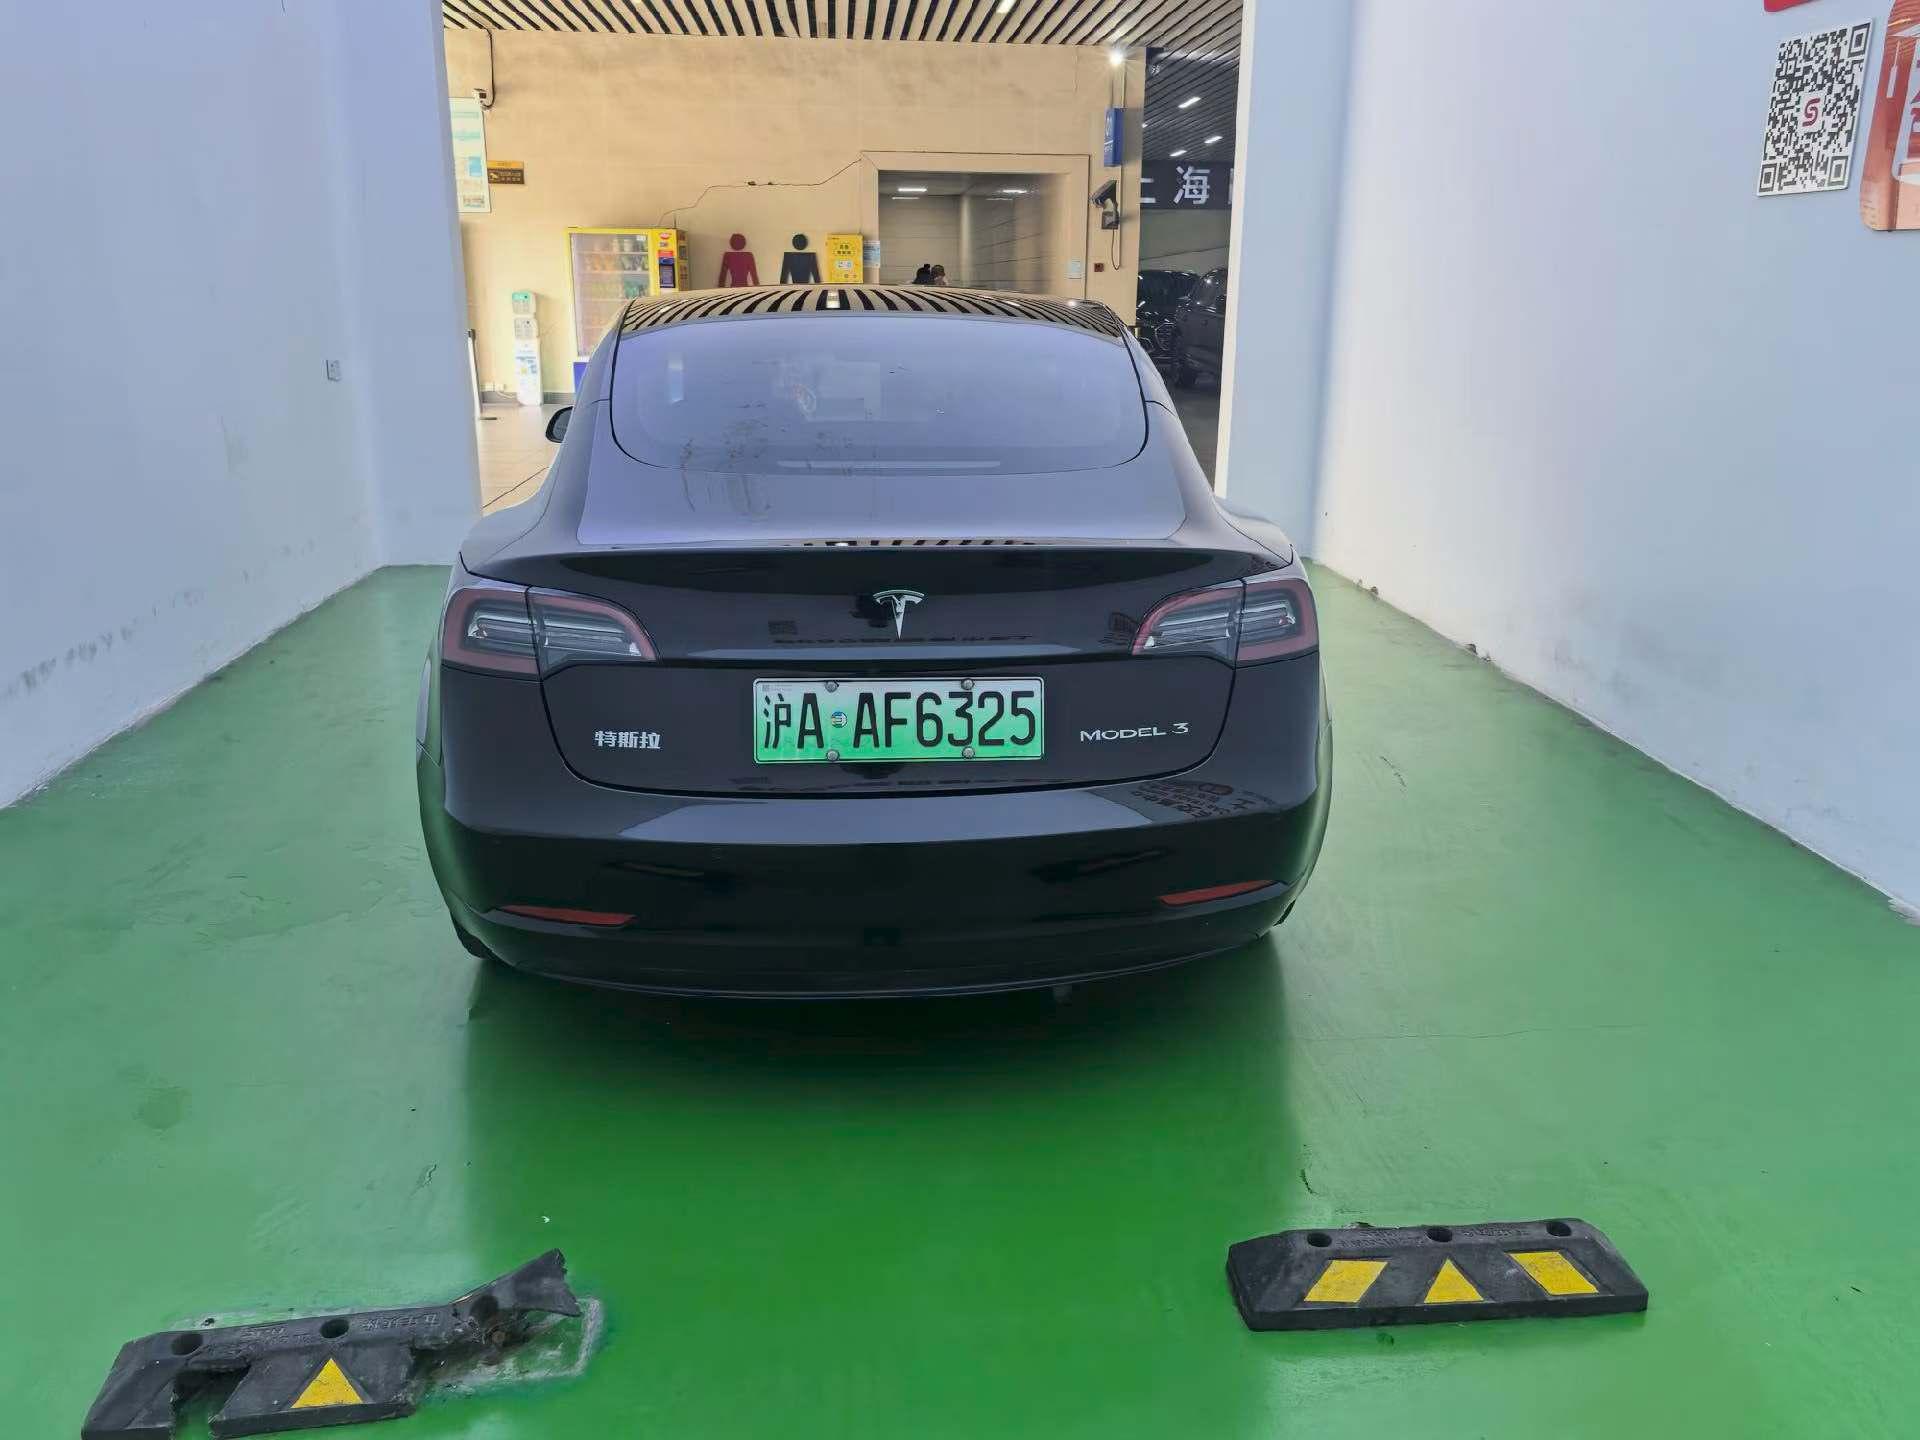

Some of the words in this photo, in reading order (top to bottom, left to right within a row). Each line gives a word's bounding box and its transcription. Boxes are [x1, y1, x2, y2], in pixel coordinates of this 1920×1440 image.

[763, 692, 825, 749] 沪A
[853, 690, 1036, 748] AF6325
[594, 730, 661, 749] 特斯拉
[1079, 726, 1167, 742] MODEL
[1172, 722, 1190, 734] 3
